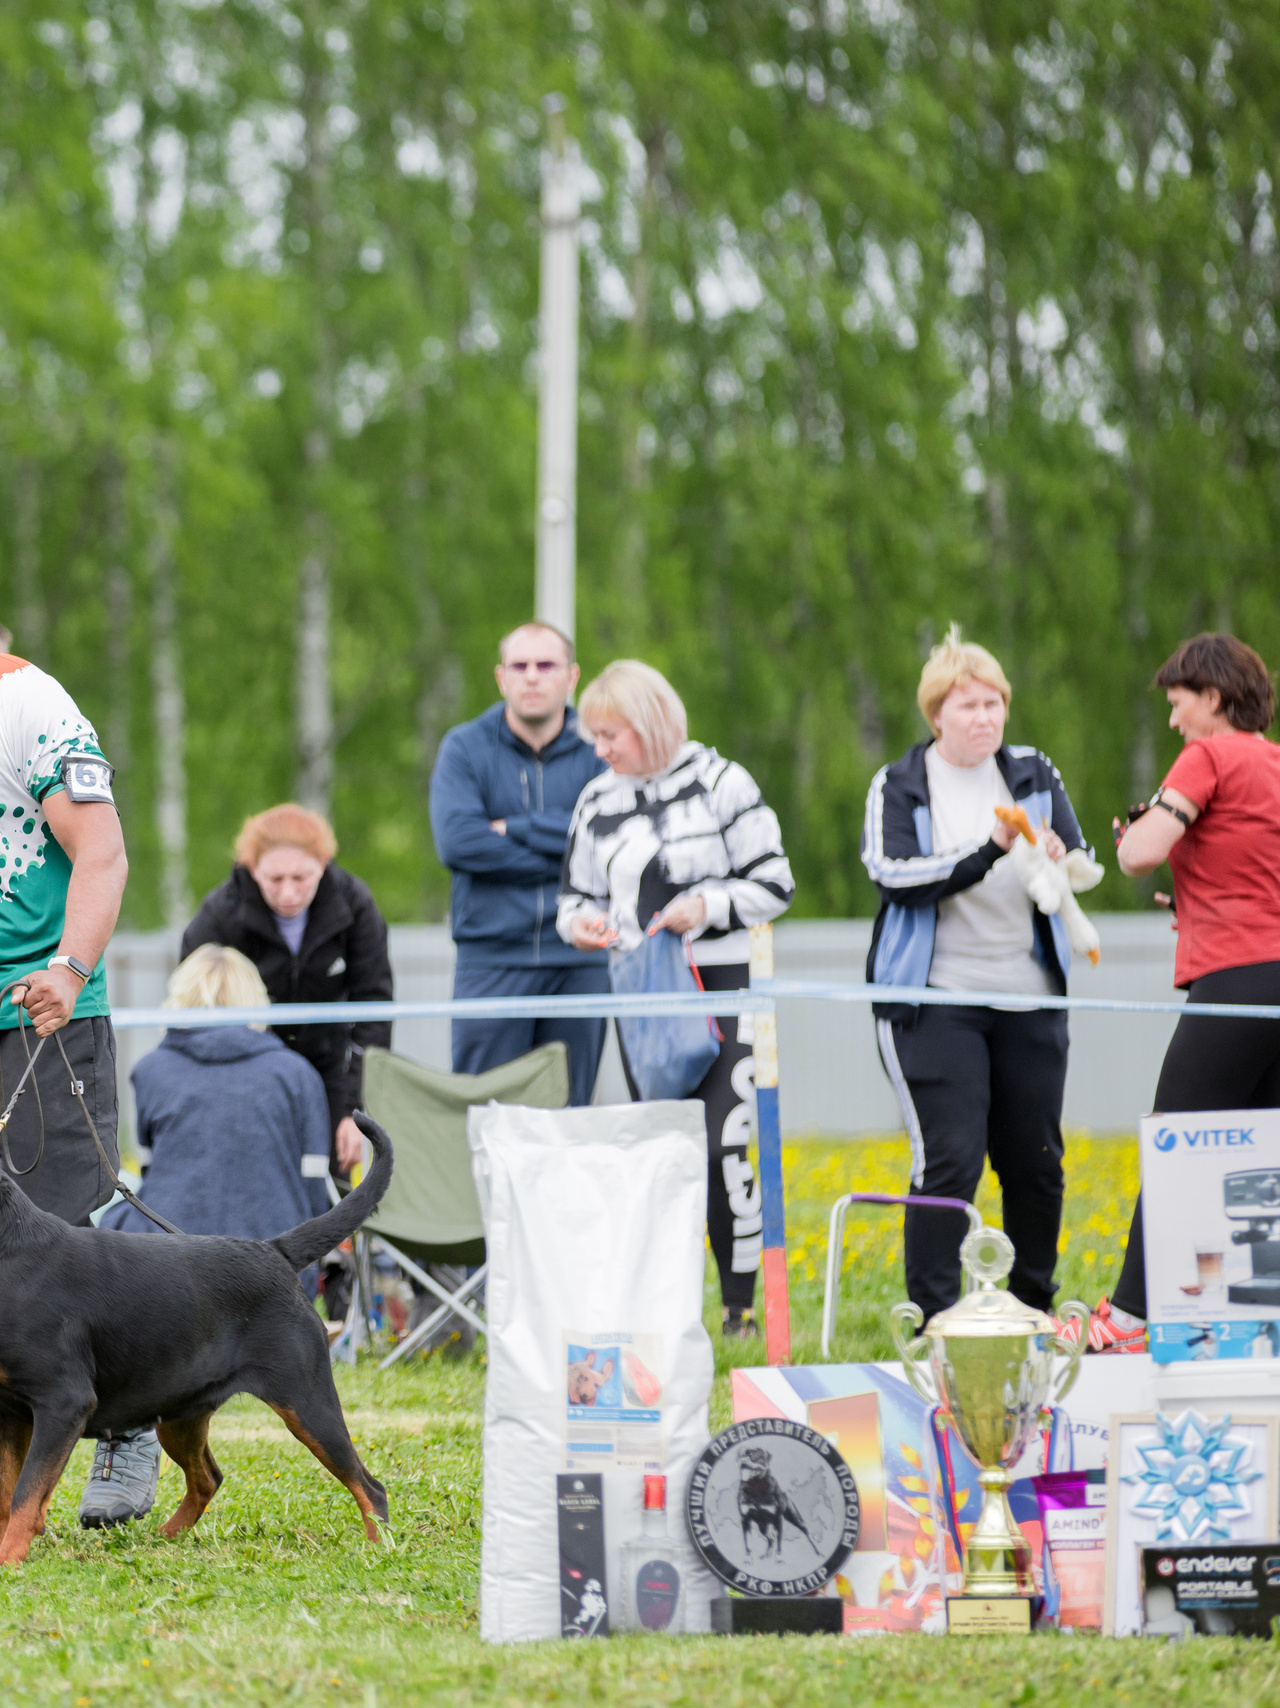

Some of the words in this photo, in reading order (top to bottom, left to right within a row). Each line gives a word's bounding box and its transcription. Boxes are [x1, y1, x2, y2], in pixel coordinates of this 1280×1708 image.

[1182, 1127, 1255, 1147] VITEK
[1154, 1326, 1165, 1343] 1
[1219, 1324, 1231, 1341] 2
[689, 1461, 714, 1547] ЛУЧШИЙ
[711, 1420, 830, 1456] ПРЕДСТАВИТЕЛЬ
[836, 1463, 858, 1549] ПОРОДЫ
[735, 1566, 828, 1594] РКФ-НКПР
[1177, 1581, 1253, 1591] PORTABLE
